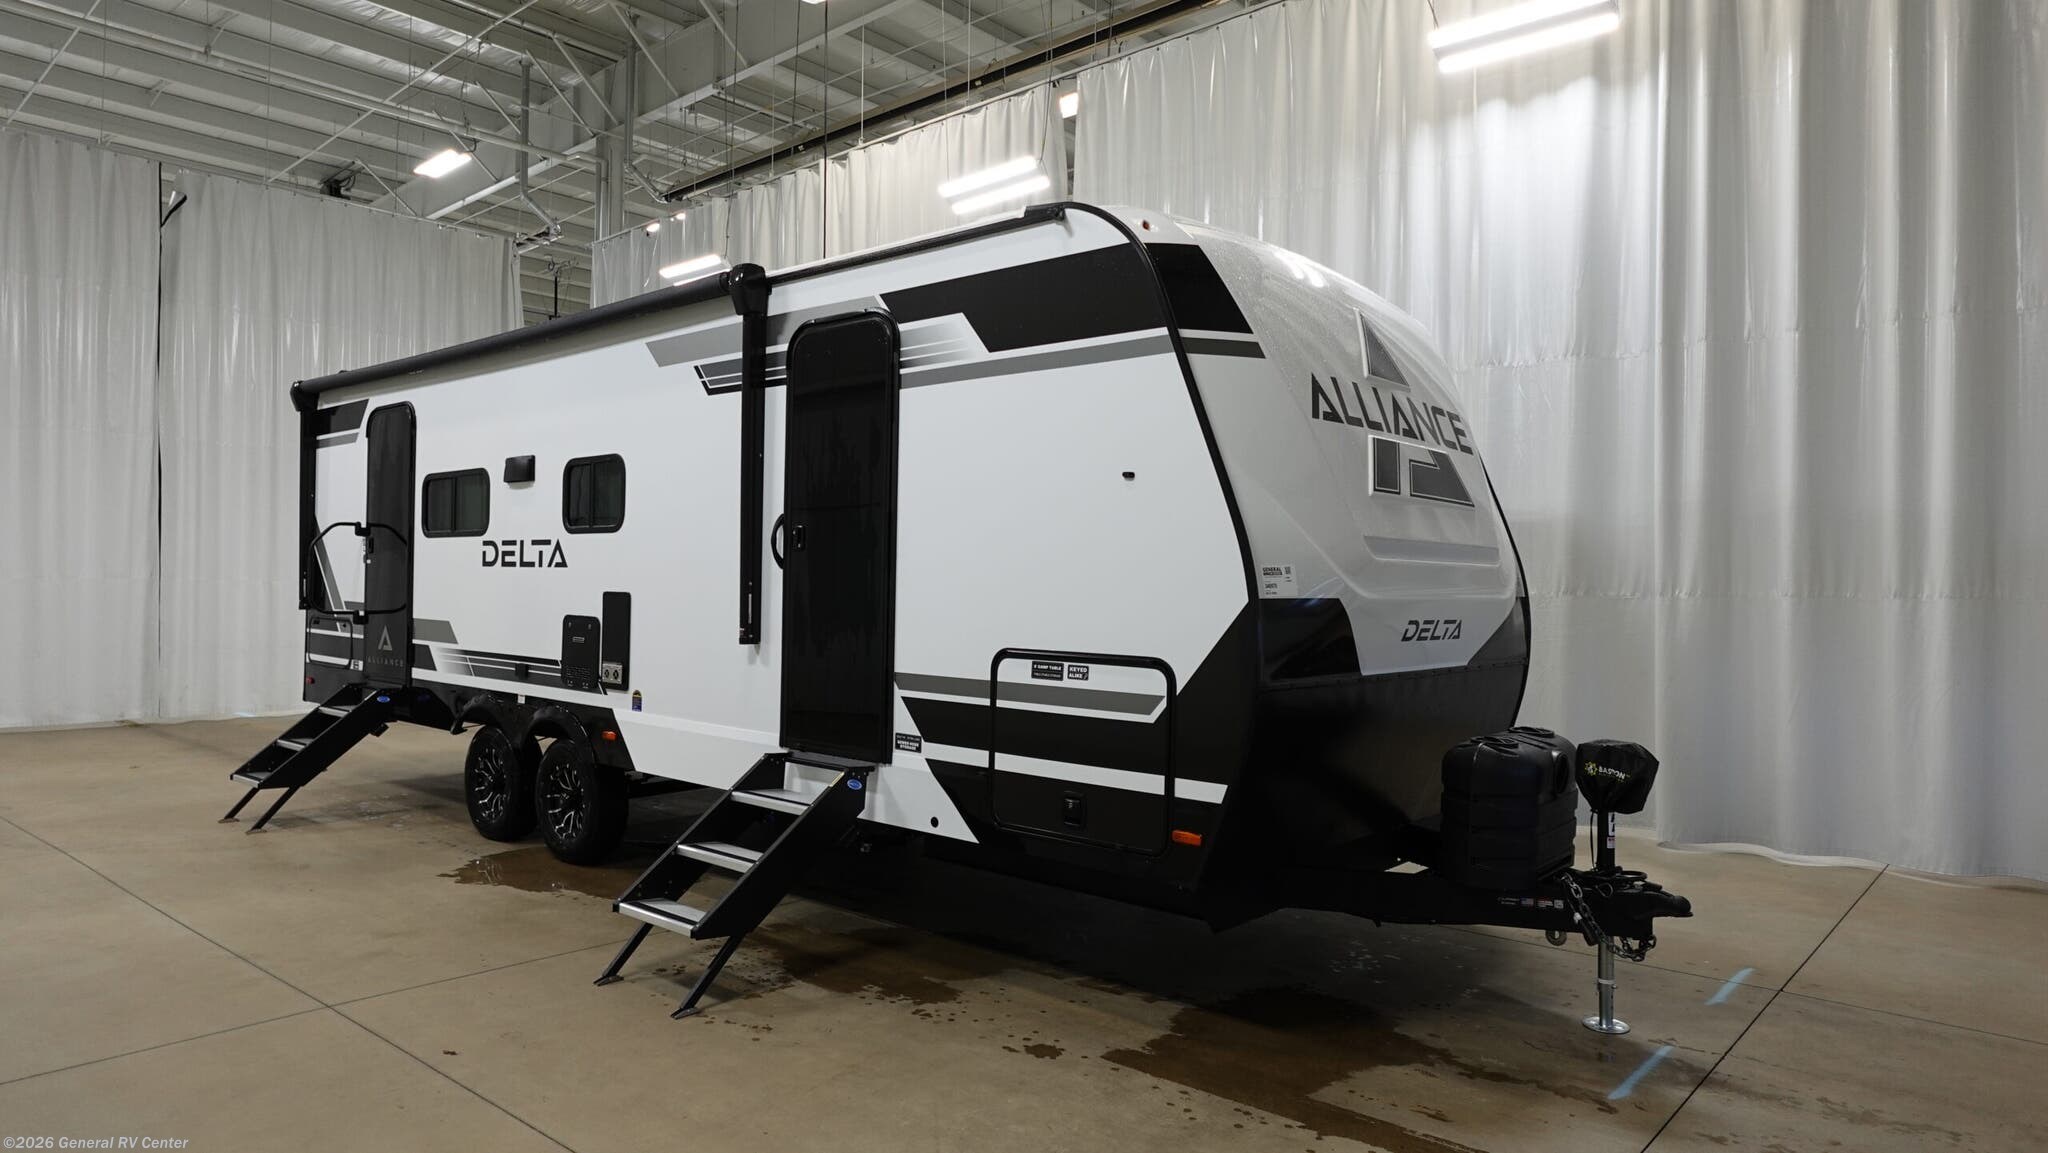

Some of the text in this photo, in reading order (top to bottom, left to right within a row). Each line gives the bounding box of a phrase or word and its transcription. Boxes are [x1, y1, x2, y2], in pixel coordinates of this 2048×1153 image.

[1311, 373, 1474, 455] ALLIANCE
[482, 538, 568, 568] DELTA
[1401, 619, 1462, 641] DELTA
